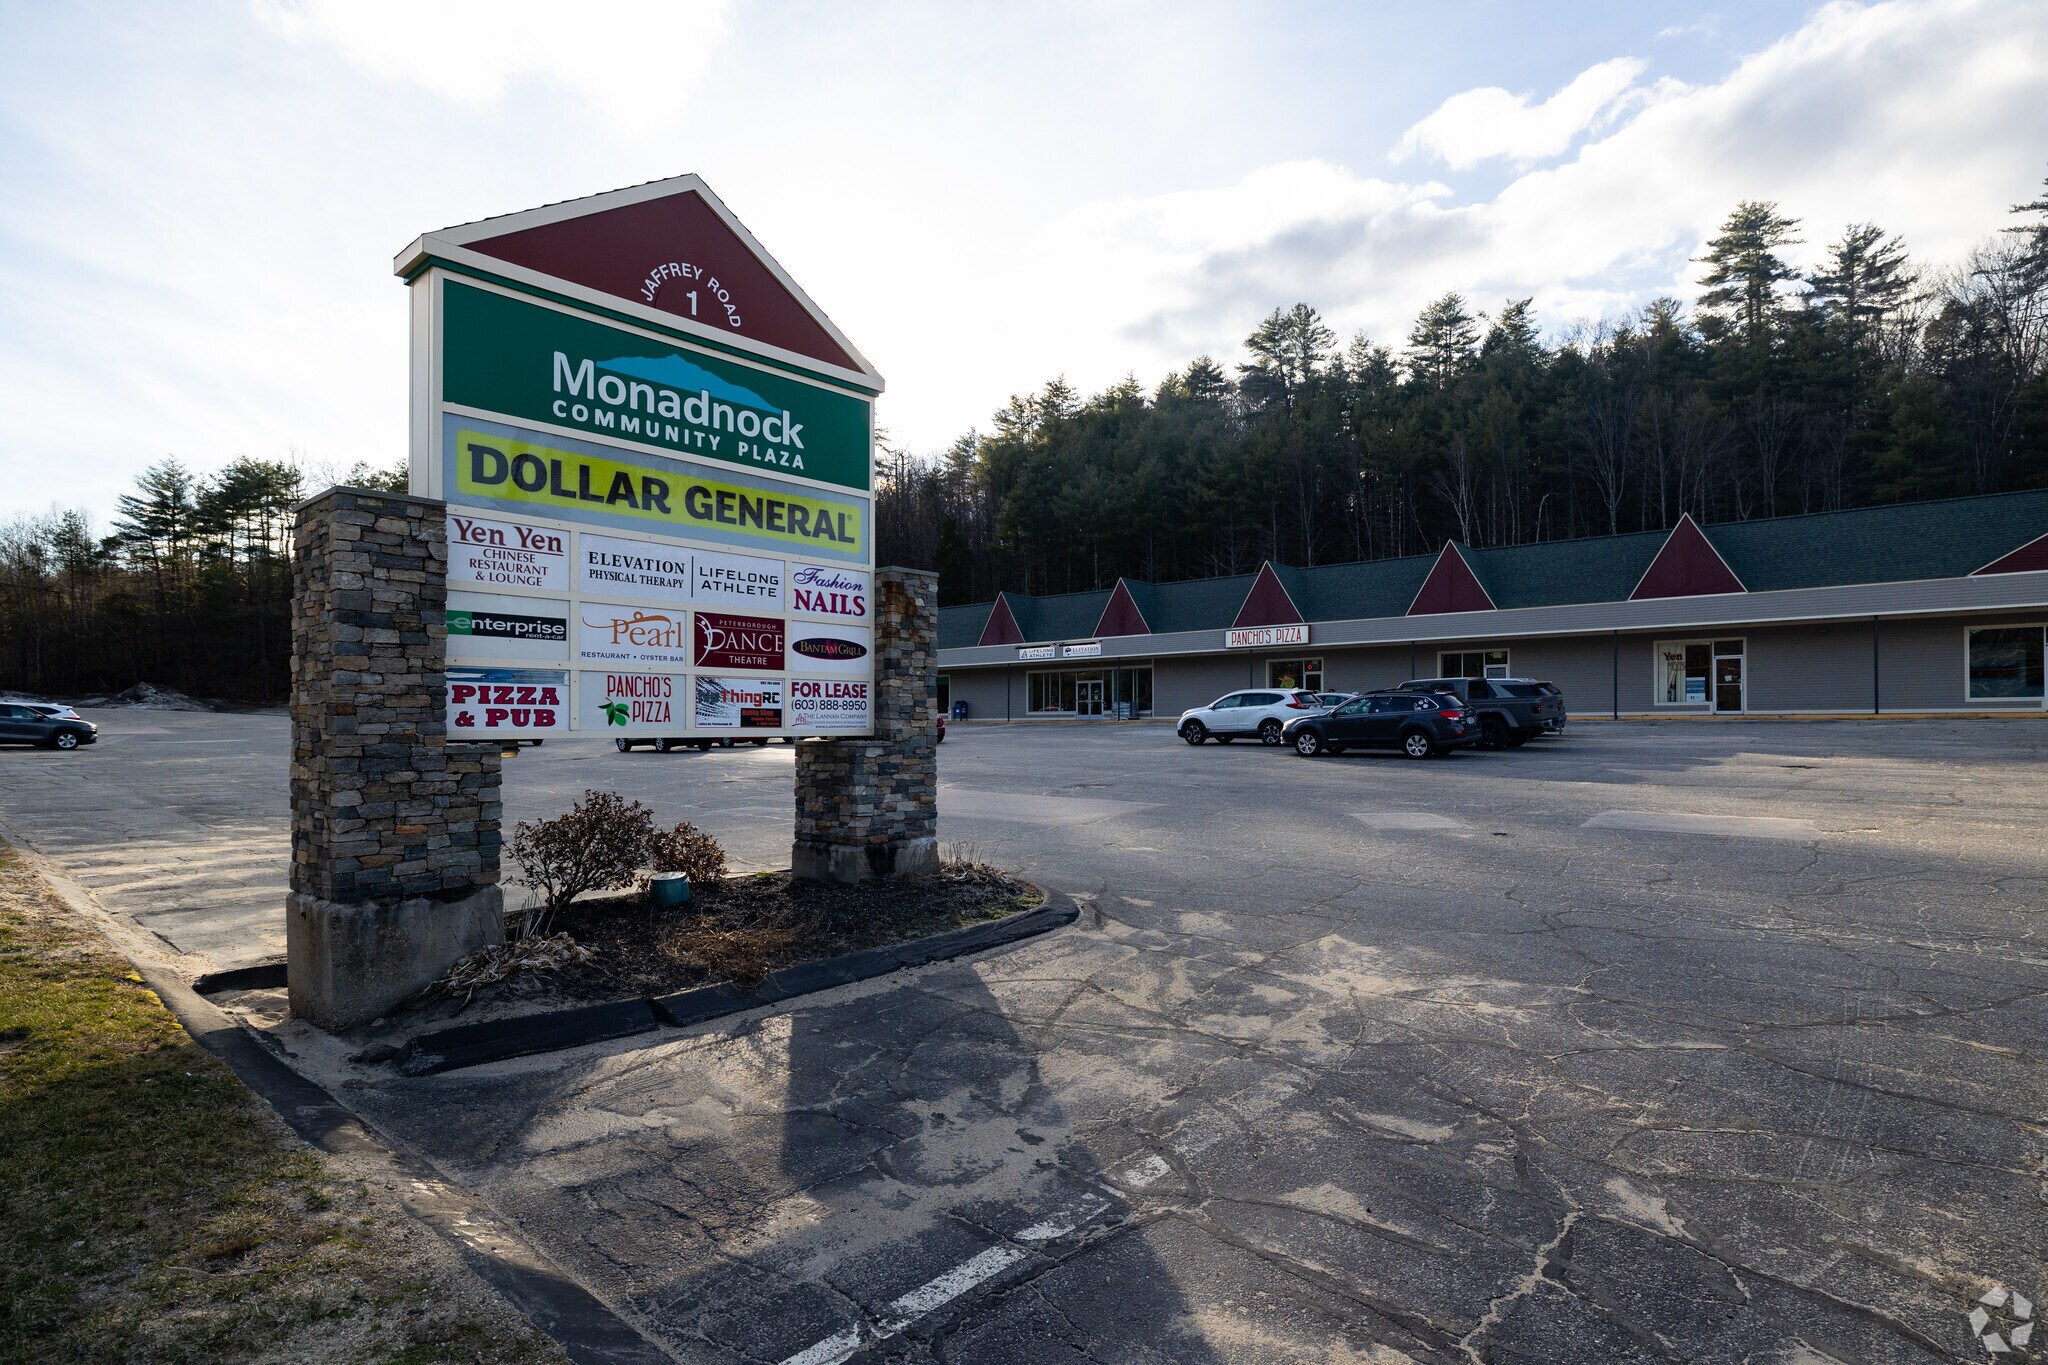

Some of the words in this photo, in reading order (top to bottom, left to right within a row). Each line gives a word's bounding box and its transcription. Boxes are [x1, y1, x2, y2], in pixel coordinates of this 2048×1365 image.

[641, 262, 703, 301] JAFFREY
[707, 276, 741, 327] ROAD
[686, 290, 698, 316] 1
[553, 351, 804, 449] Monadnock
[552, 400, 720, 451] COMMUNITY
[738, 441, 805, 470] PLAZA
[467, 443, 672, 515] DOLLAR
[452, 518, 507, 546] Yen
[513, 526, 564, 553] Yen
[483, 548, 536, 564] CHINESE
[588, 551, 686, 575] ELEVATION
[469, 558, 549, 576] RESTAURANT
[699, 566, 780, 586] LIFELONG
[475, 571, 485, 581] &
[489, 572, 543, 587] LOUNGE
[589, 569, 637, 584] PHYSICAL
[639, 575, 685, 589] THERAPY
[701, 580, 778, 598] ATHLETE
[793, 568, 864, 592] Fashion
[793, 589, 866, 617] NAILS
[454, 616, 565, 635] enterprise
[611, 614, 684, 648] Pearl
[719, 620, 777, 630] PETERBOROUGH
[703, 628, 784, 653] DANCE
[1231, 629, 1272, 646] PANCHO'S
[1276, 627, 1302, 643] PIZZA
[581, 651, 631, 660] RESTAURANT
[640, 654, 668, 662] OYSTER
[729, 655, 768, 666] THEATRE
[1663, 651, 1684, 661] Yen
[452, 685, 560, 705] PIZZA
[607, 674, 672, 698] PANCHO'S
[791, 682, 822, 698] FOR
[825, 683, 868, 699] LEASE
[632, 700, 671, 723] PIZZA
[791, 699, 818, 712] (603)
[819, 700, 867, 711] 888-8950
[455, 711, 475, 727] &
[486, 708, 556, 727] PUB
